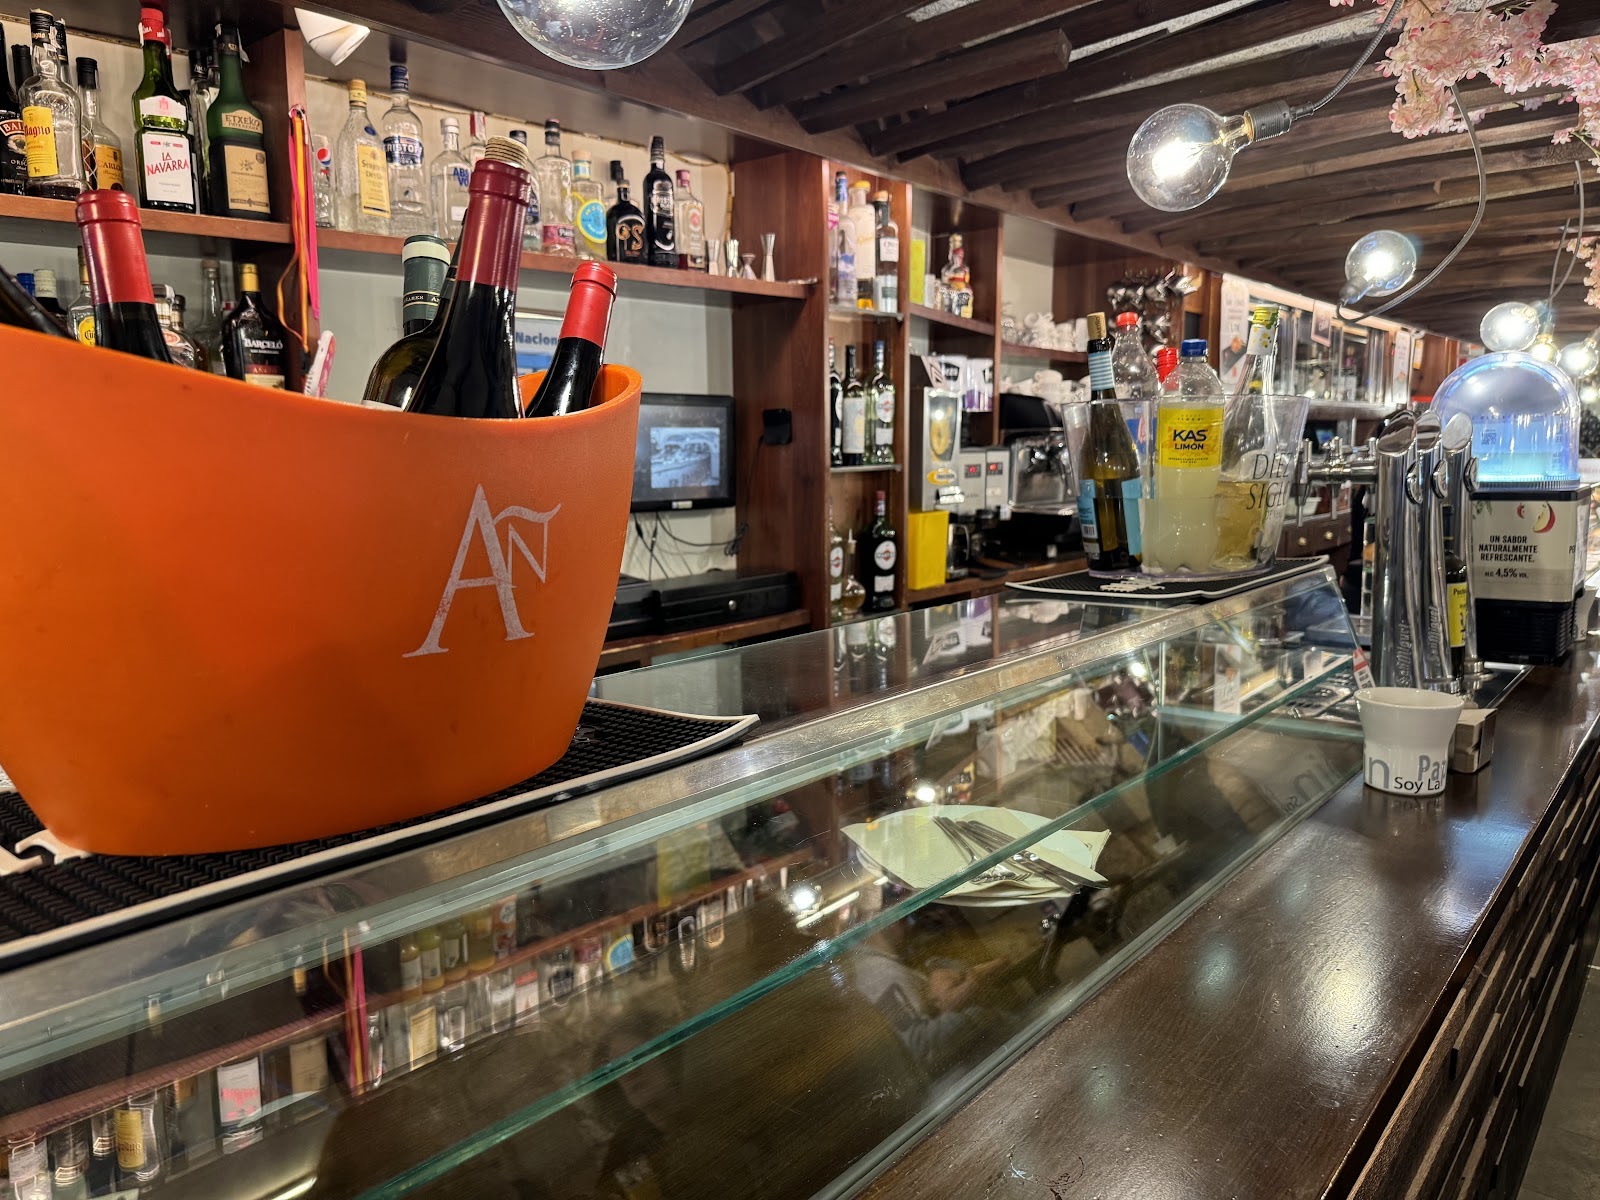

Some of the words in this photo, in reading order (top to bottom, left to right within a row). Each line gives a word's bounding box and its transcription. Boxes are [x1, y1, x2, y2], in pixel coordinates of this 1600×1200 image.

[162, 152, 173, 161] LA
[146, 159, 190, 177] NAVARRA
[243, 337, 284, 350] BARCELÓ
[515, 331, 559, 347] Nacion
[1173, 429, 1208, 442] KAS
[1490, 535, 1501, 543] UN
[1502, 535, 1528, 543] SABOR
[1479, 543, 1538, 554] NATURALMENTE
[1480, 552, 1535, 563] REFRESCANTE.
[1393, 776, 1424, 794] Soy
